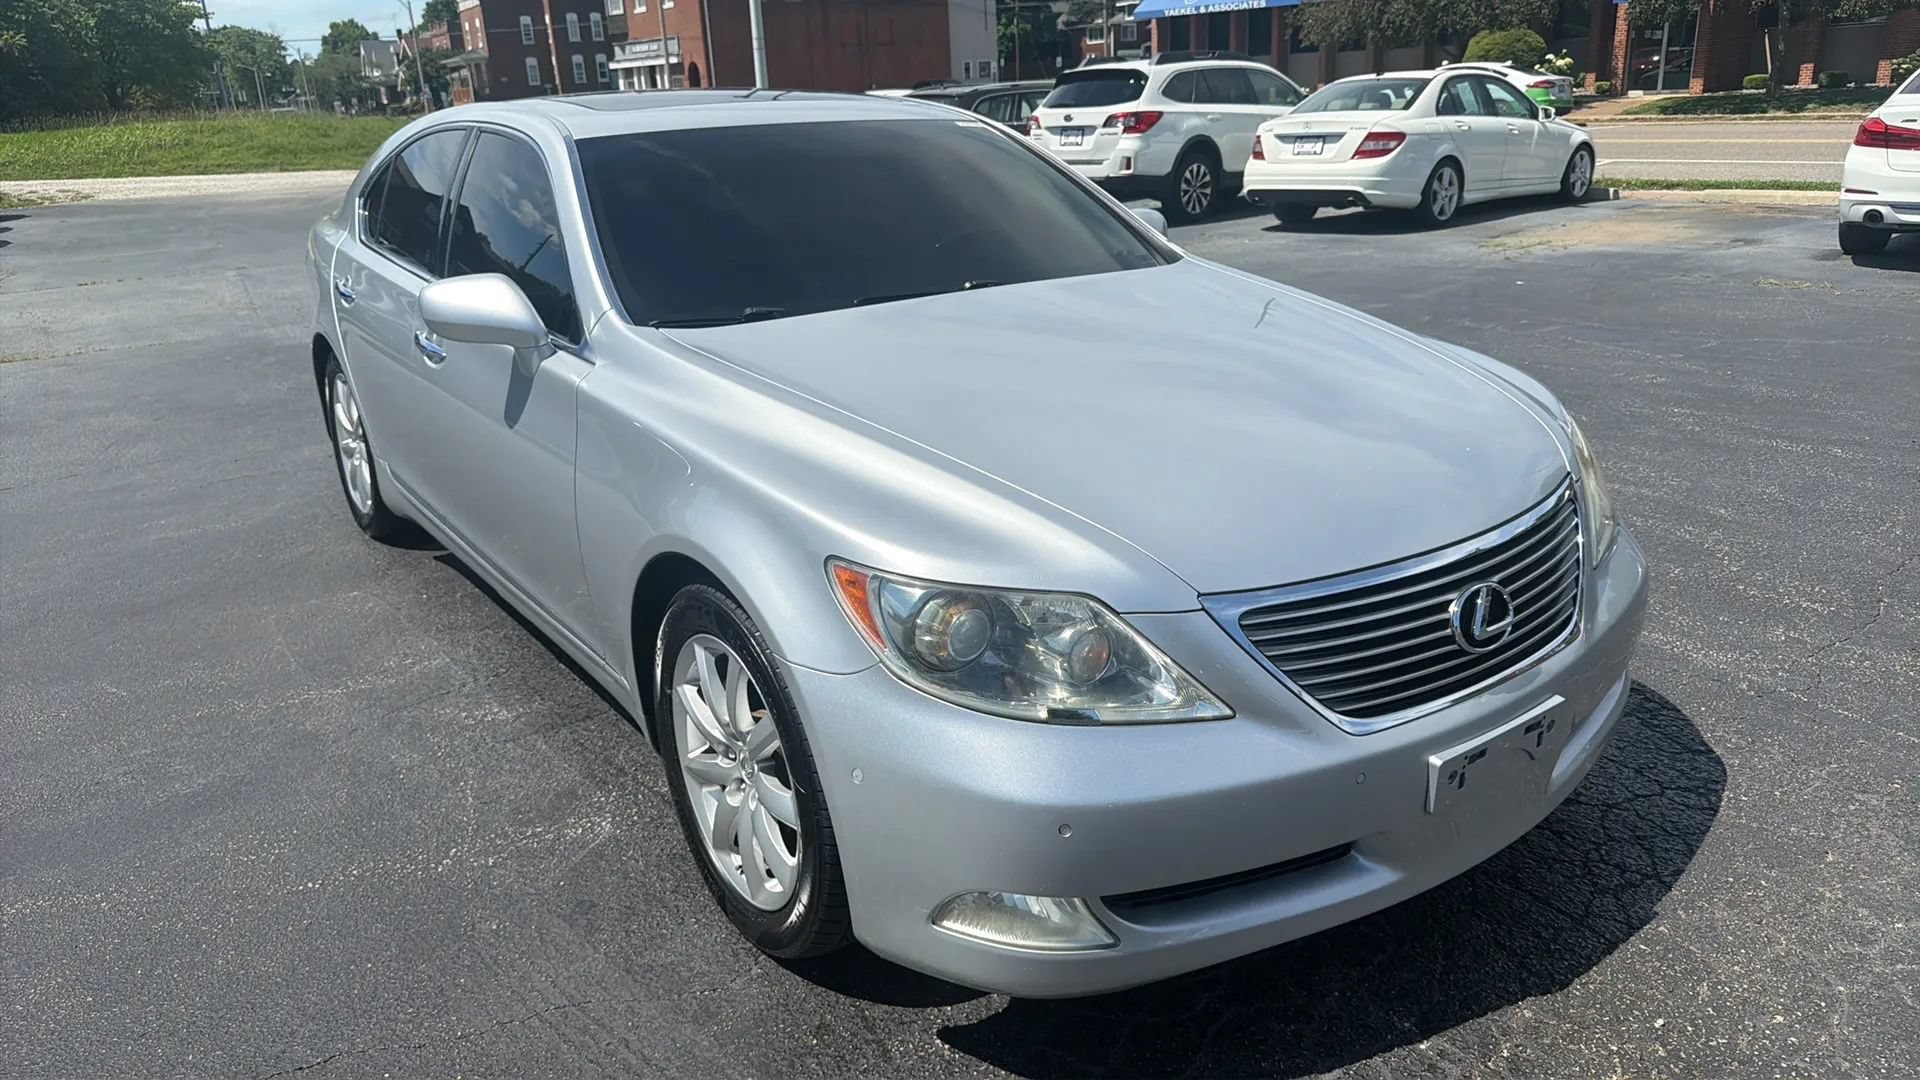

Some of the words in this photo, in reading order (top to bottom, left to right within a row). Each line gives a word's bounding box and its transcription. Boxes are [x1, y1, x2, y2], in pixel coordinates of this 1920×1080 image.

[1164, 7, 1198, 17] YAEKEL
[1199, 5, 1207, 14] &
[1208, 0, 1266, 13] ASSOCIATES
